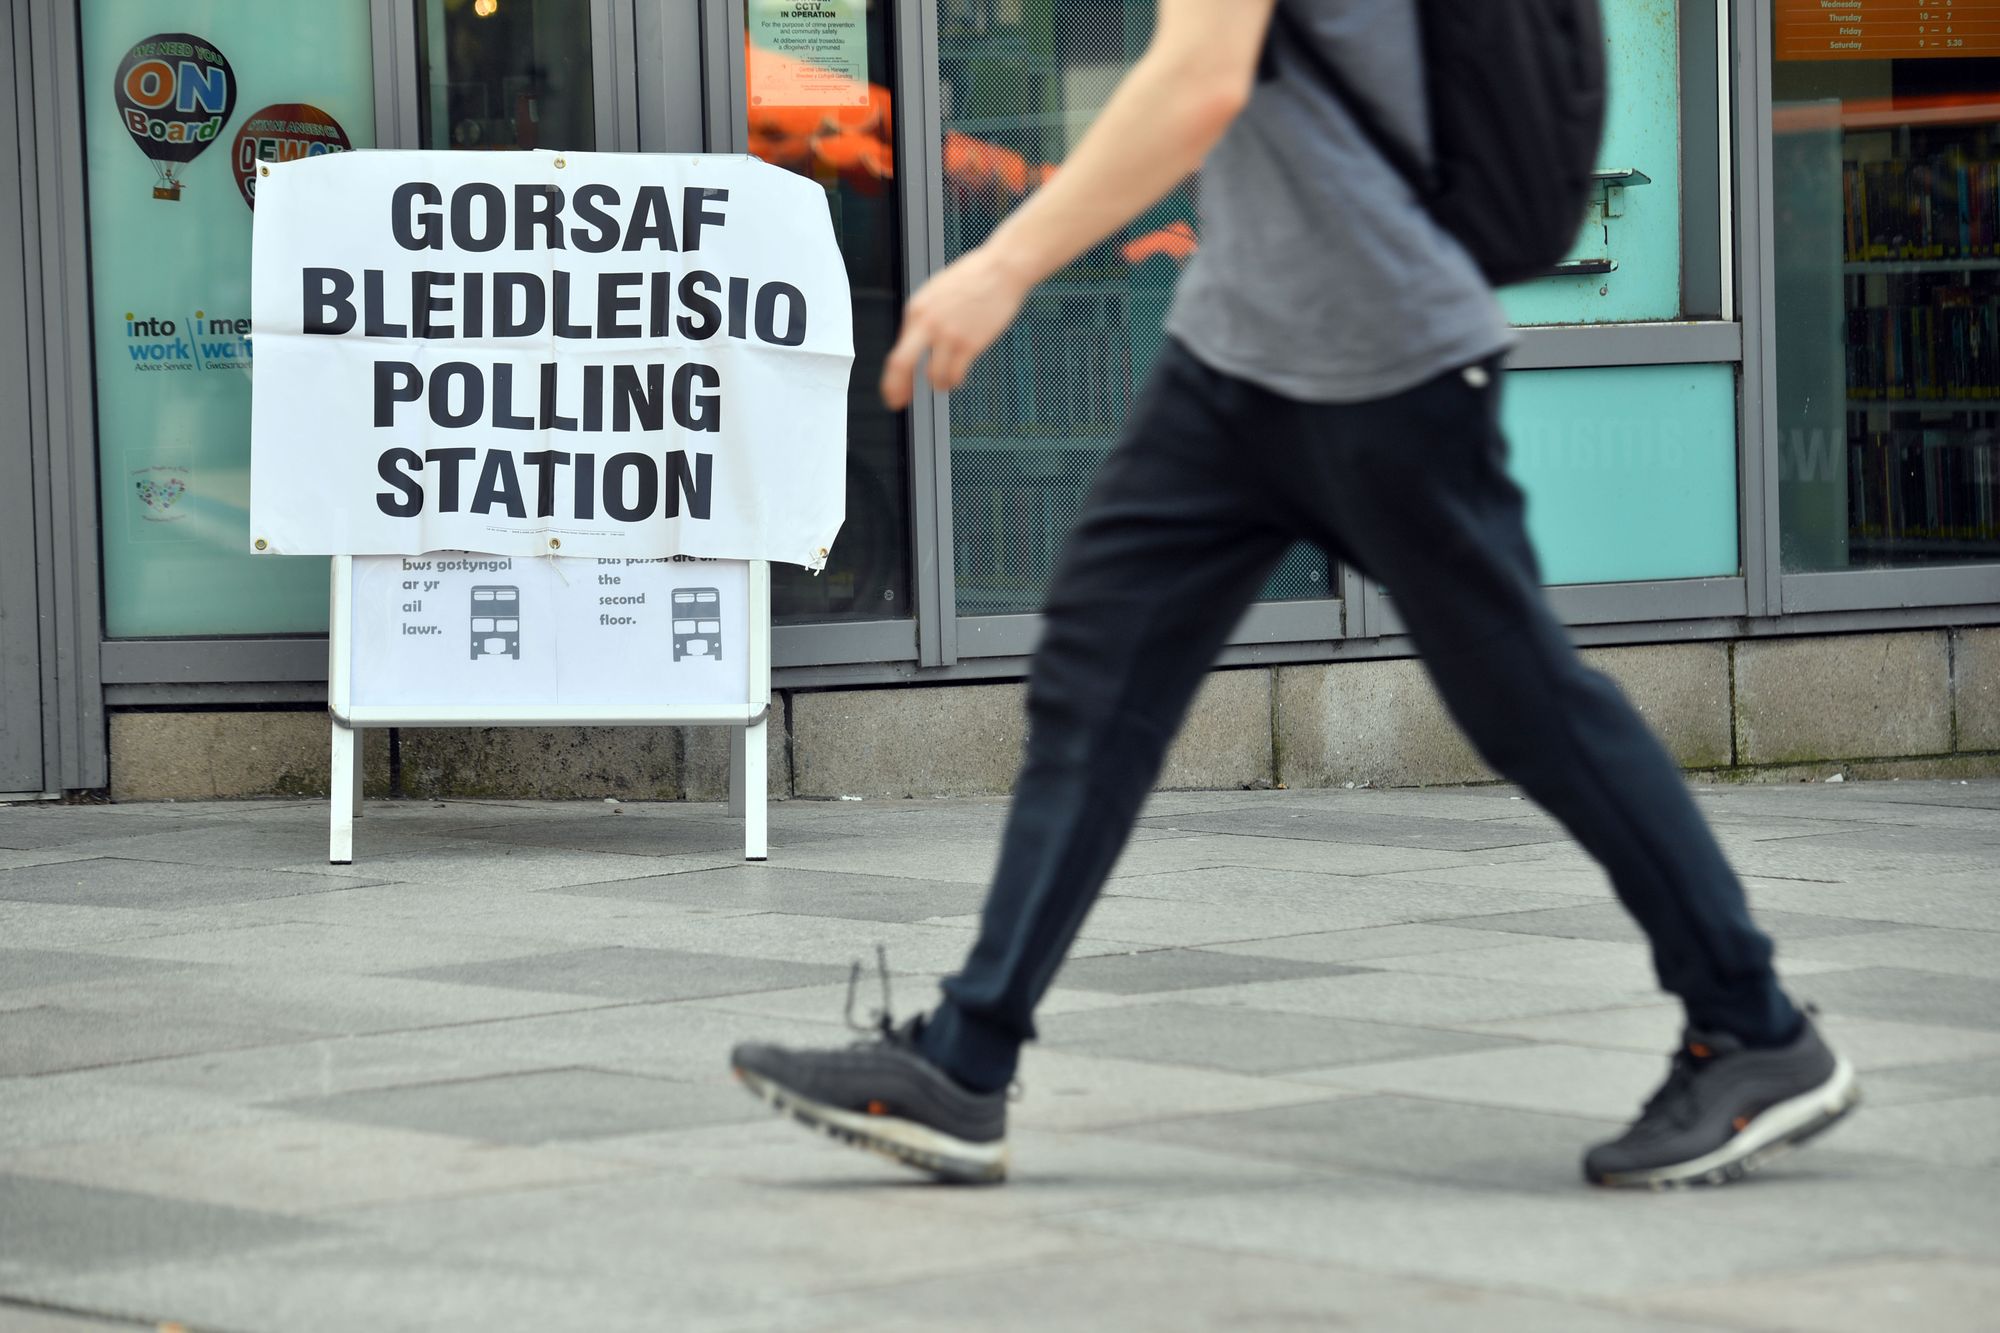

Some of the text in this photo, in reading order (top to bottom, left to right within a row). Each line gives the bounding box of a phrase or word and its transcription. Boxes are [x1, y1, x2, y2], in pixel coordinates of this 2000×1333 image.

[795, 2, 821, 10] CCTV
[1820, 0, 1862, 8] Wednesday
[1829, 14, 1862, 22] Thursday
[1840, 28, 1862, 36] Friday
[1830, 41, 1862, 50] Saturday
[133, 41, 224, 66] WE NEED YOU
[124, 59, 226, 114] ON
[124, 107, 222, 144] Board
[240, 136, 343, 172] DEW
[391, 181, 729, 253] GORSAF
[302, 267, 807, 346] BLEIDLEISIO
[125, 312, 176, 337] into
[195, 310, 252, 336] i me
[128, 338, 190, 360] work
[201, 336, 253, 358] wait
[135, 362, 193, 371] Advice Service
[373, 361, 721, 433] POLLING
[376, 446, 713, 522] STATION
[402, 558, 512, 572] bws gostyngol
[402, 580, 440, 592] ar yr
[598, 574, 621, 585] the
[402, 600, 422, 612] ail
[600, 593, 645, 605] second
[600, 614, 637, 626] floor.
[402, 622, 442, 635] lawr.
